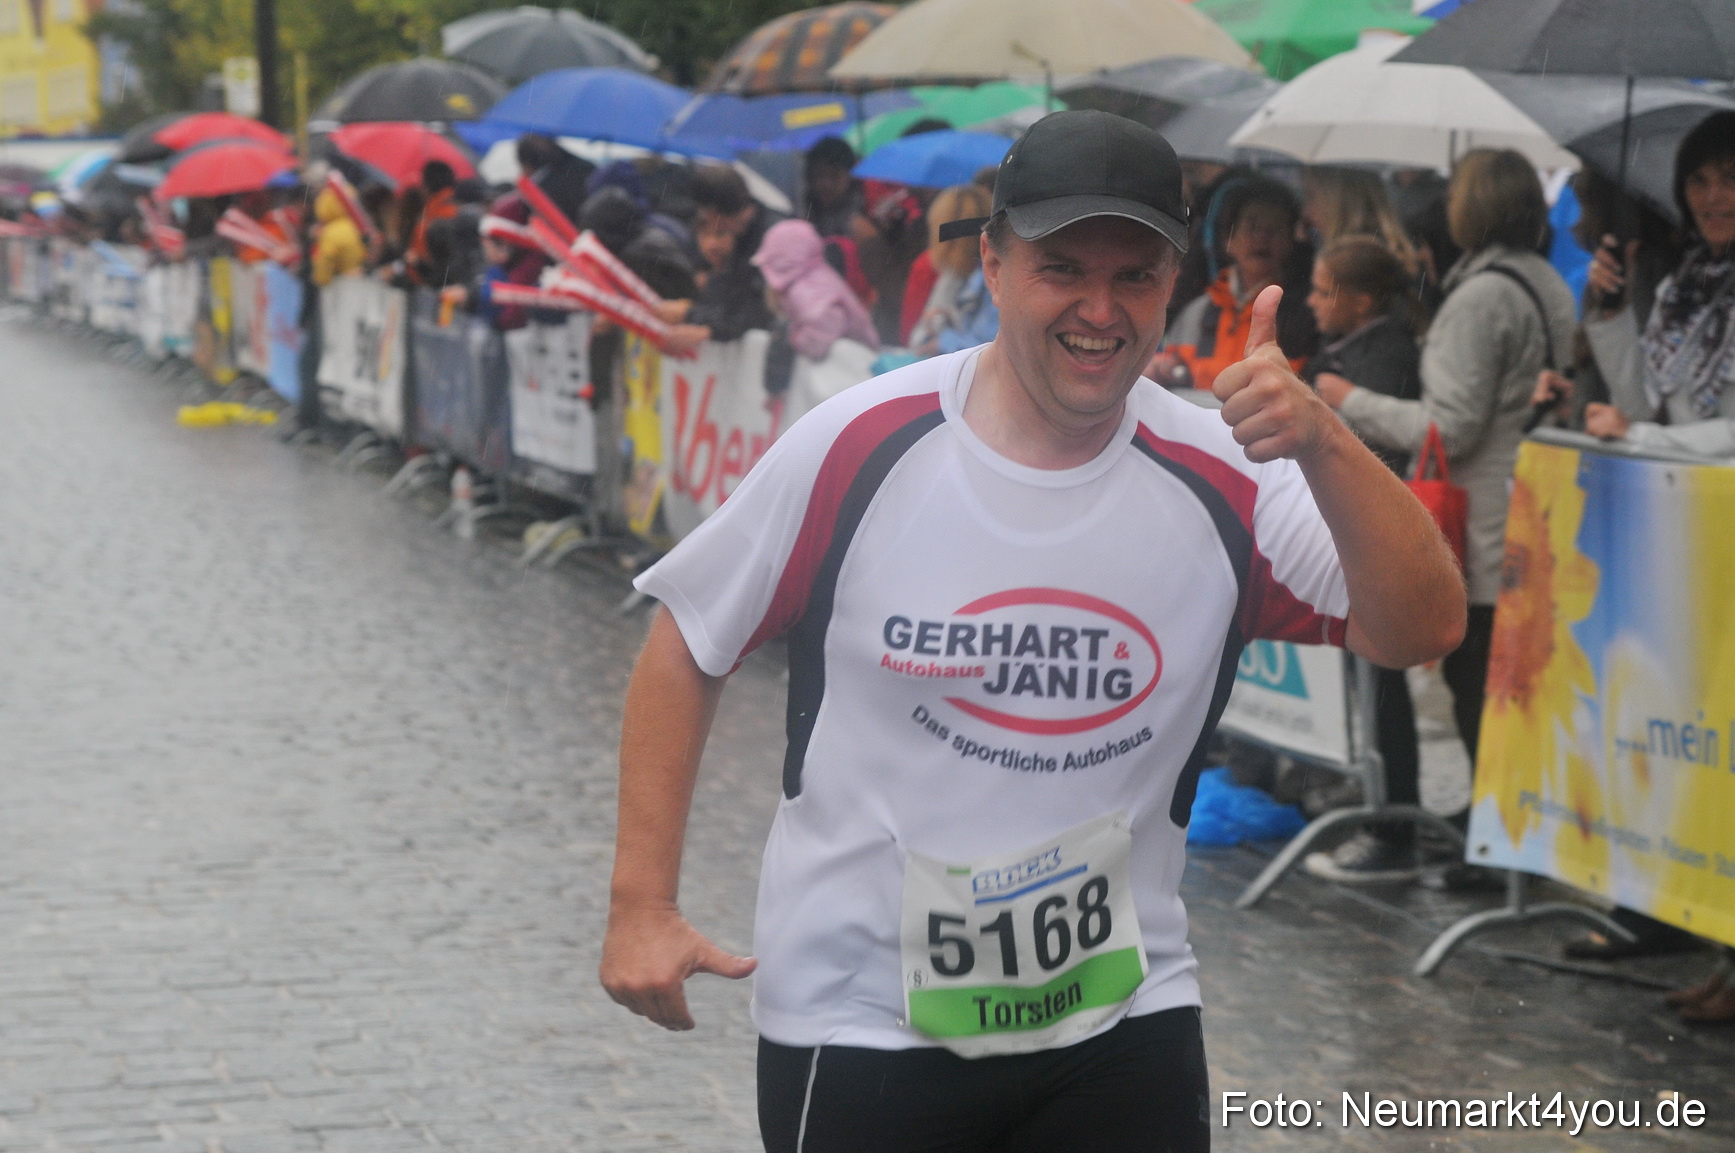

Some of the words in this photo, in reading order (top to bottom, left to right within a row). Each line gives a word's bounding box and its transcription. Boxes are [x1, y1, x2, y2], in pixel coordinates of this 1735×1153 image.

[883, 615, 1109, 663] GERHART
[1113, 640, 1131, 661] &
[880, 652, 986, 680] Autohaus
[982, 661, 1133, 702] JÄNIG
[911, 704, 951, 742] Das
[952, 734, 1058, 773] sportliche
[1062, 726, 1154, 773] Autohaus
[927, 874, 1113, 980] 5168
[972, 981, 1083, 1029] Torsten
